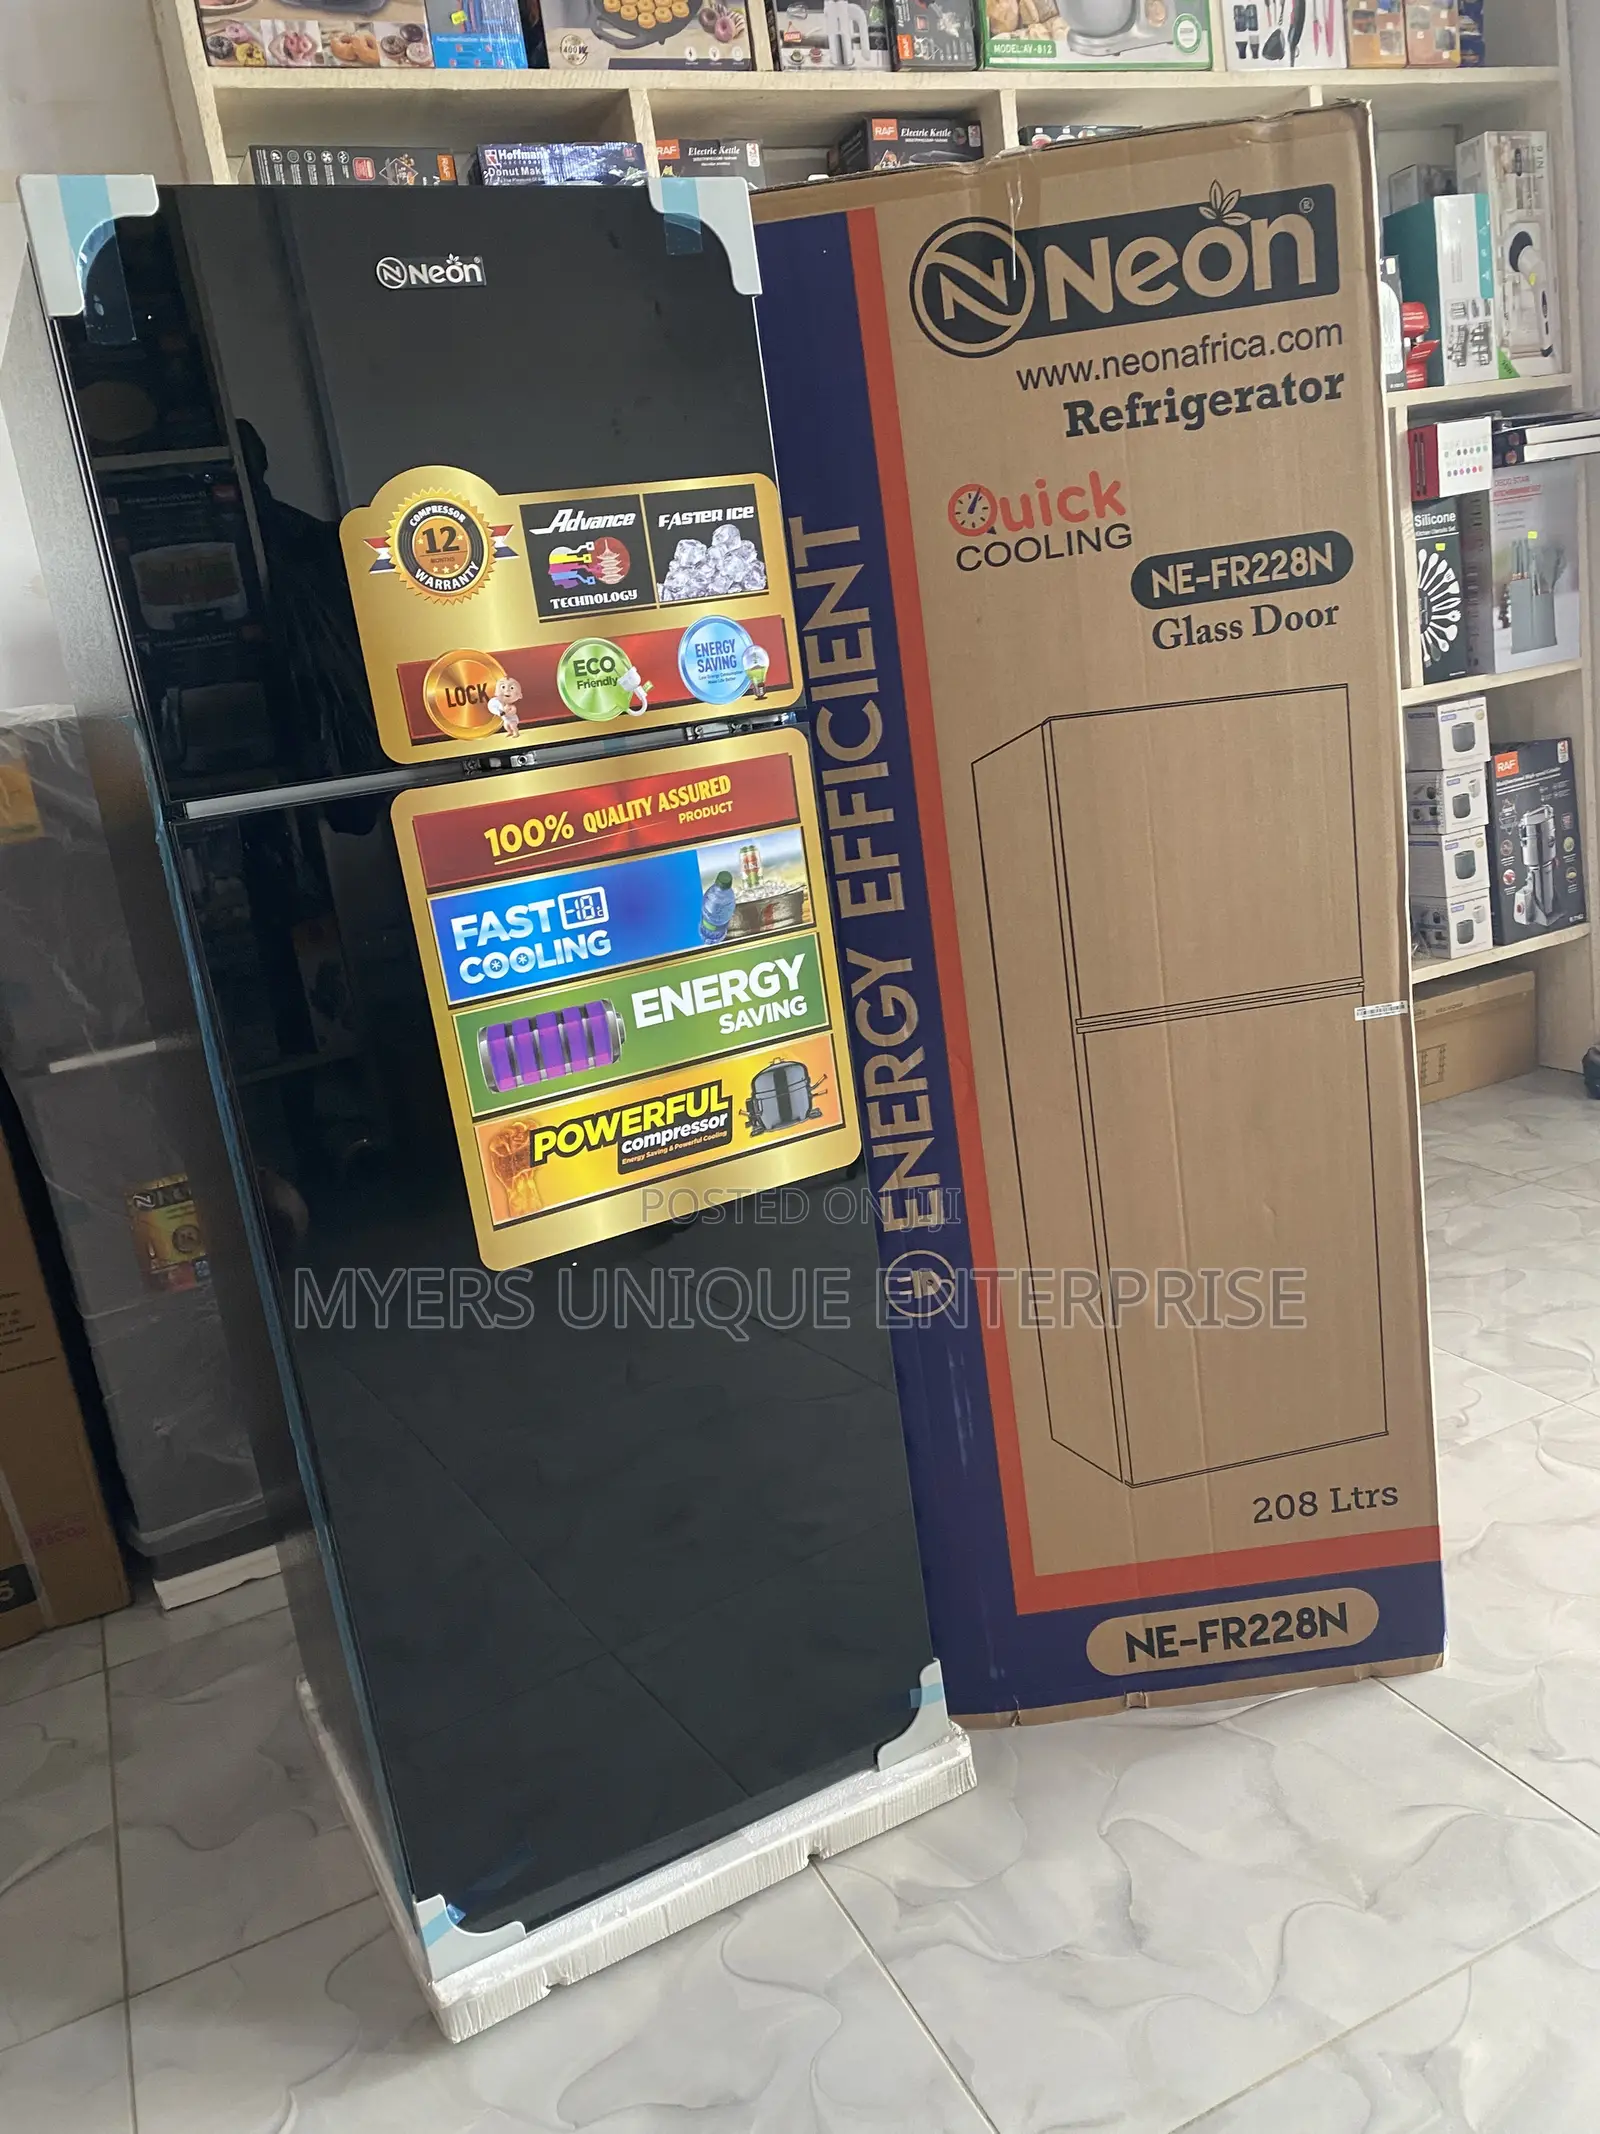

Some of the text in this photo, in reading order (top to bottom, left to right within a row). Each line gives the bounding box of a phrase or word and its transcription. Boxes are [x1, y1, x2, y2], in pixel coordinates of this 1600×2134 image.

[875, 126, 895, 136] RAF
[900, 128, 952, 137] Electric Kettle
[657, 145, 677, 155] RAF
[688, 146, 740, 156] Electric Kettle
[441, 157, 450, 177] RAF
[488, 167, 519, 176] Donut
[408, 259, 482, 285] Neon
[1043, 200, 1318, 322] Neon
[1016, 322, 1343, 391] www.neonafrica.com
[1063, 371, 1345, 437] Refrigerator
[409, 505, 466, 527] COMPRESSOR
[658, 506, 754, 530] FASTER ICE
[947, 471, 1128, 538] Quick
[529, 508, 636, 535] Advance
[1414, 512, 1456, 527] Silicone
[422, 526, 460, 553] 12
[956, 523, 1133, 572] COOLING
[414, 561, 479, 590] WARRANTY
[1151, 541, 1334, 599] NE-FR228N
[550, 589, 638, 609] TECHNOLOGY
[1152, 603, 1340, 651] Glass Door
[694, 639, 735, 658] ENERGY
[573, 656, 616, 677] ECO
[697, 654, 737, 673] SAVING
[445, 682, 490, 708] LOCK
[576, 676, 619, 690] Friendly
[788, 516, 905, 920] EFFICIENT
[1497, 759, 1517, 772] RAF
[583, 775, 731, 834] QUALITY ASSURED
[678, 801, 733, 824] PRODUCT
[484, 811, 575, 857] 100%
[451, 899, 554, 951] FAST
[459, 929, 612, 985] COOLING
[631, 953, 806, 1030] ENERGY
[718, 996, 808, 1036] SAVING
[845, 947, 946, 1234] ENERGY
[534, 1086, 730, 1162] POWERFUL
[621, 1112, 728, 1154] compressor
[622, 1153, 645, 1165] Energy
[646, 1147, 668, 1158] Saving
[675, 1137, 703, 1150] Powerful
[703, 1130, 728, 1142] Cooling
[1252, 1486, 1399, 1524] 208 Ltrs
[1126, 1601, 1349, 1663] NE-FR228N
